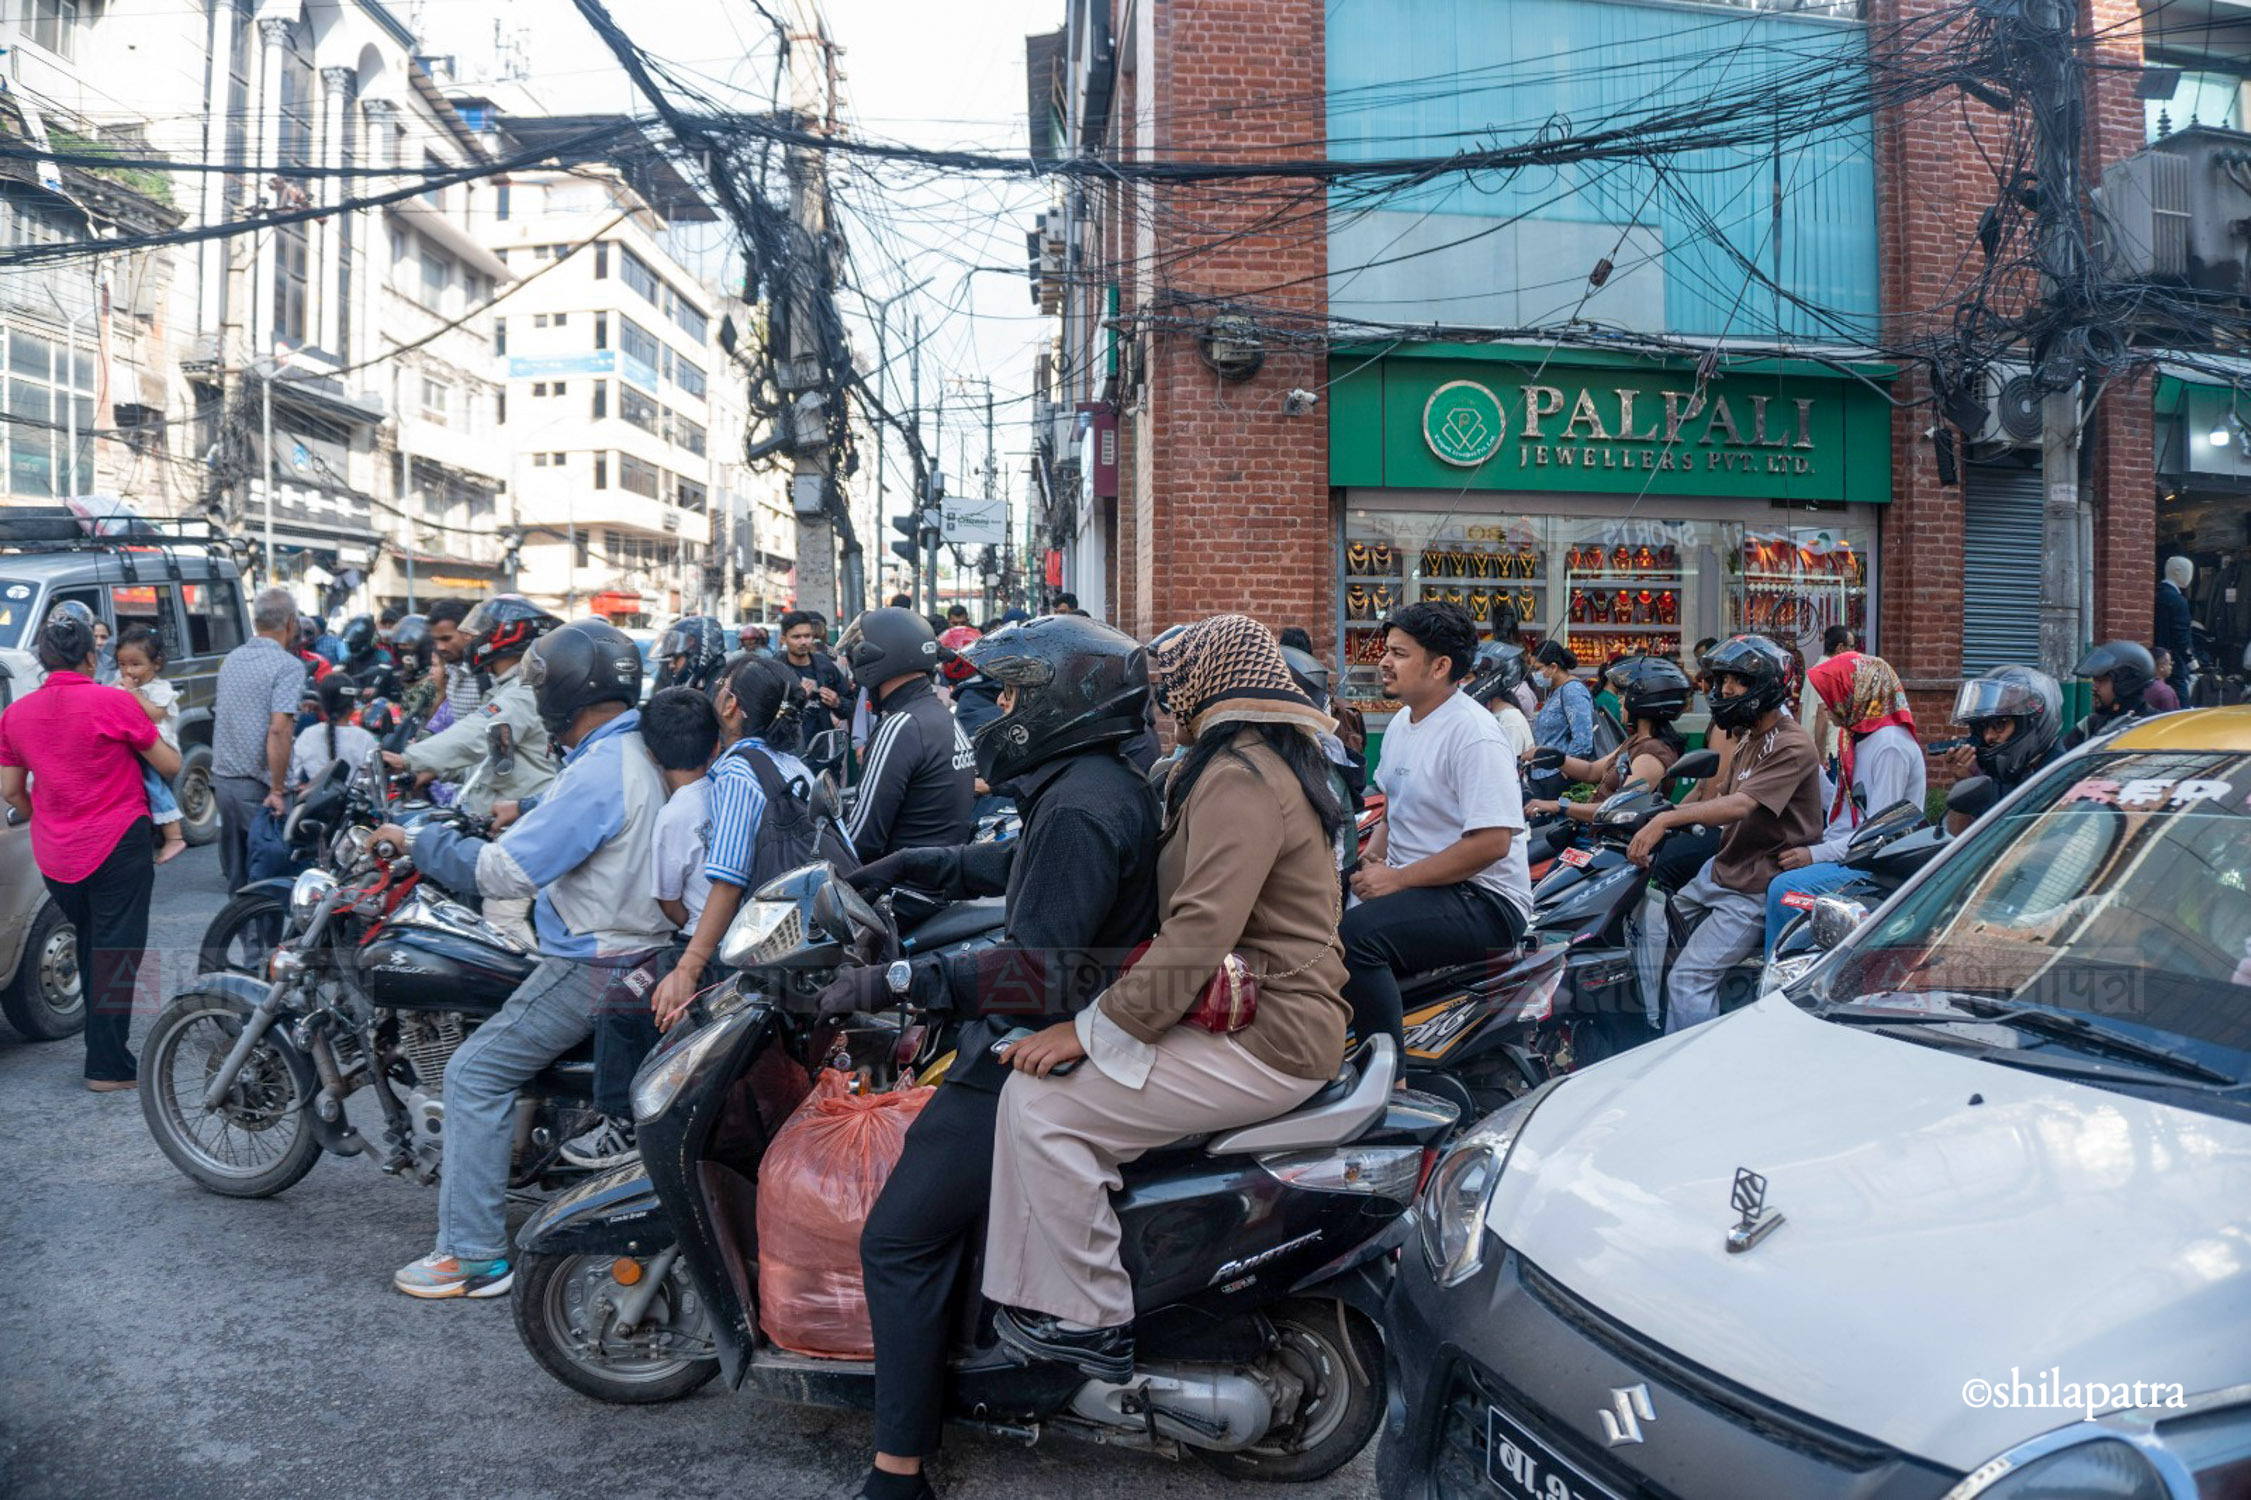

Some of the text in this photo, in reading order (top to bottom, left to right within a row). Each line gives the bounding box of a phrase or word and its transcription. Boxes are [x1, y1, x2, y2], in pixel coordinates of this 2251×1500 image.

[1520, 385, 1816, 449] PALPALI
[1520, 445, 1816, 474] JEWELLERS PVT. LTD.
